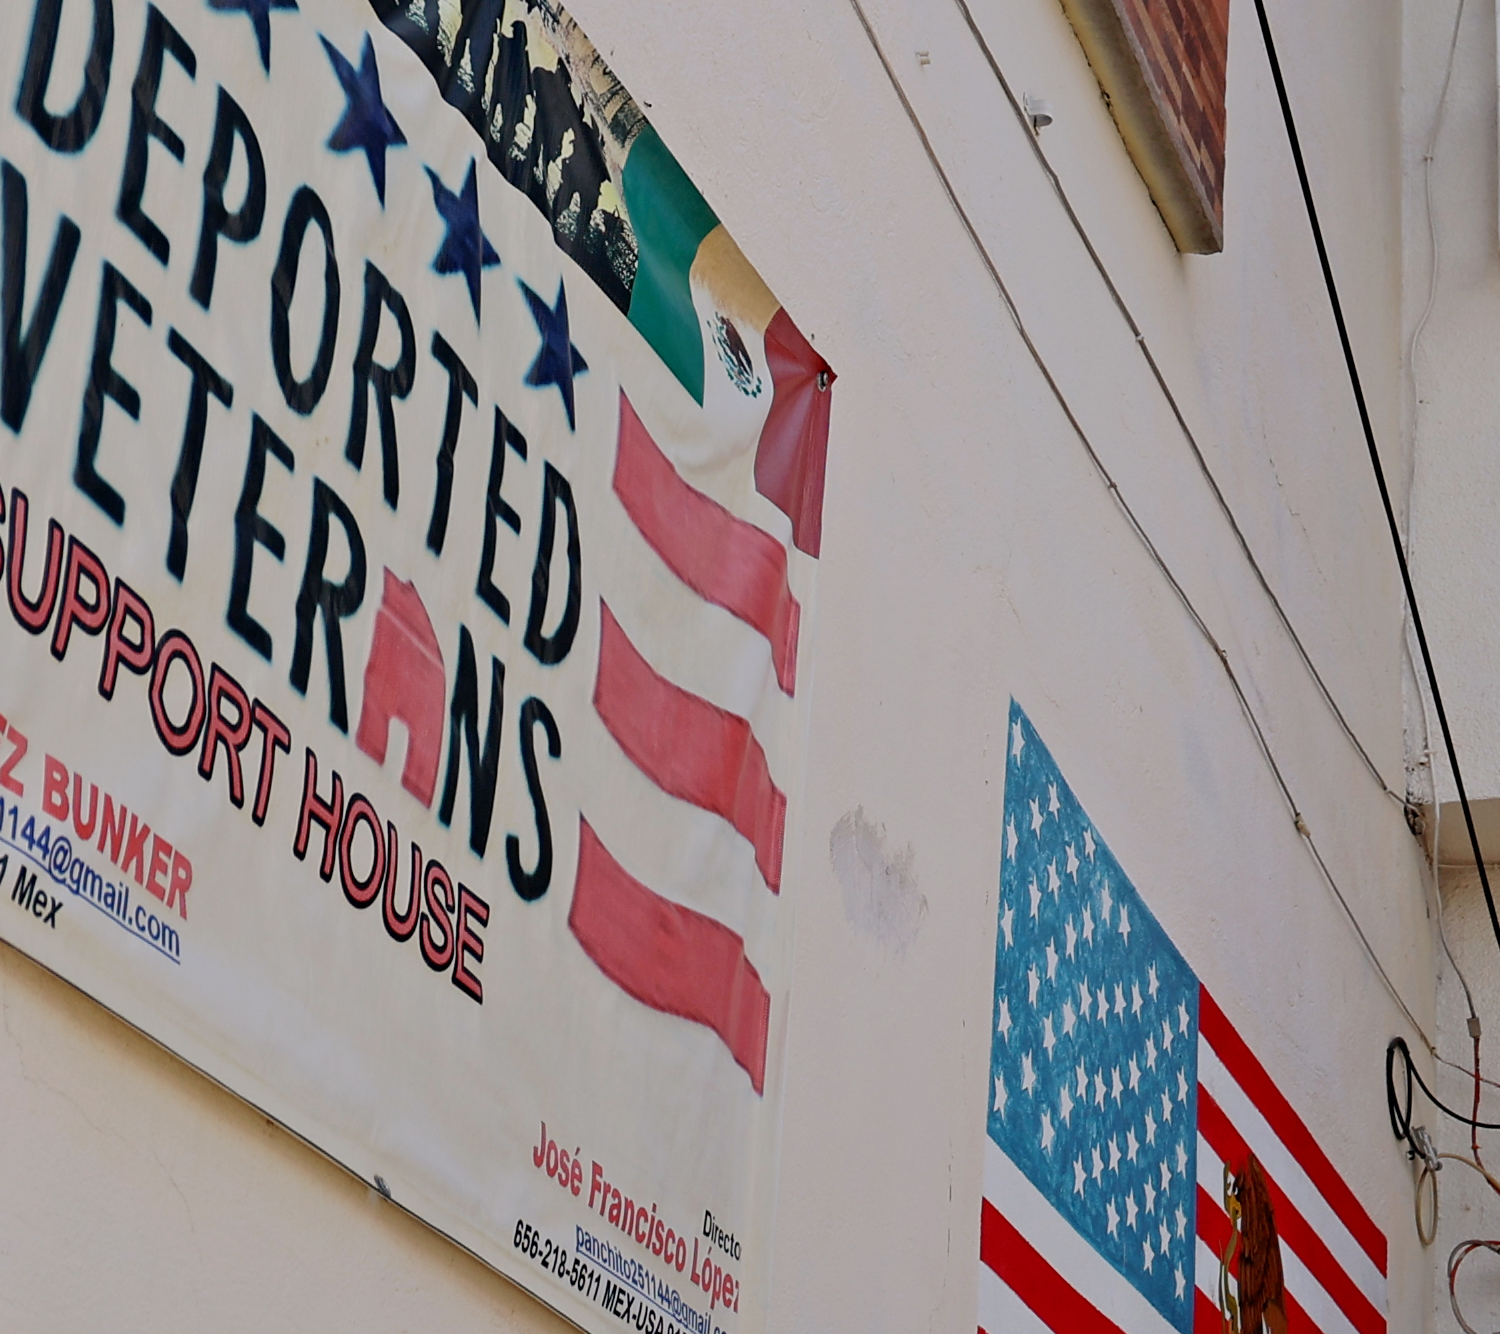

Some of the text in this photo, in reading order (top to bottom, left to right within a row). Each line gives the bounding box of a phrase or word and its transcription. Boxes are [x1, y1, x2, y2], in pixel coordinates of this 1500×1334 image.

[10, 865, 63, 929] Mex
[42, 752, 193, 920] BUNKER
[293, 747, 490, 1005] HOUSE
[513, 1219, 602, 1302] 656-218-5611
[533, 1120, 583, 1197] José
[588, 1160, 687, 1272] Francisco
